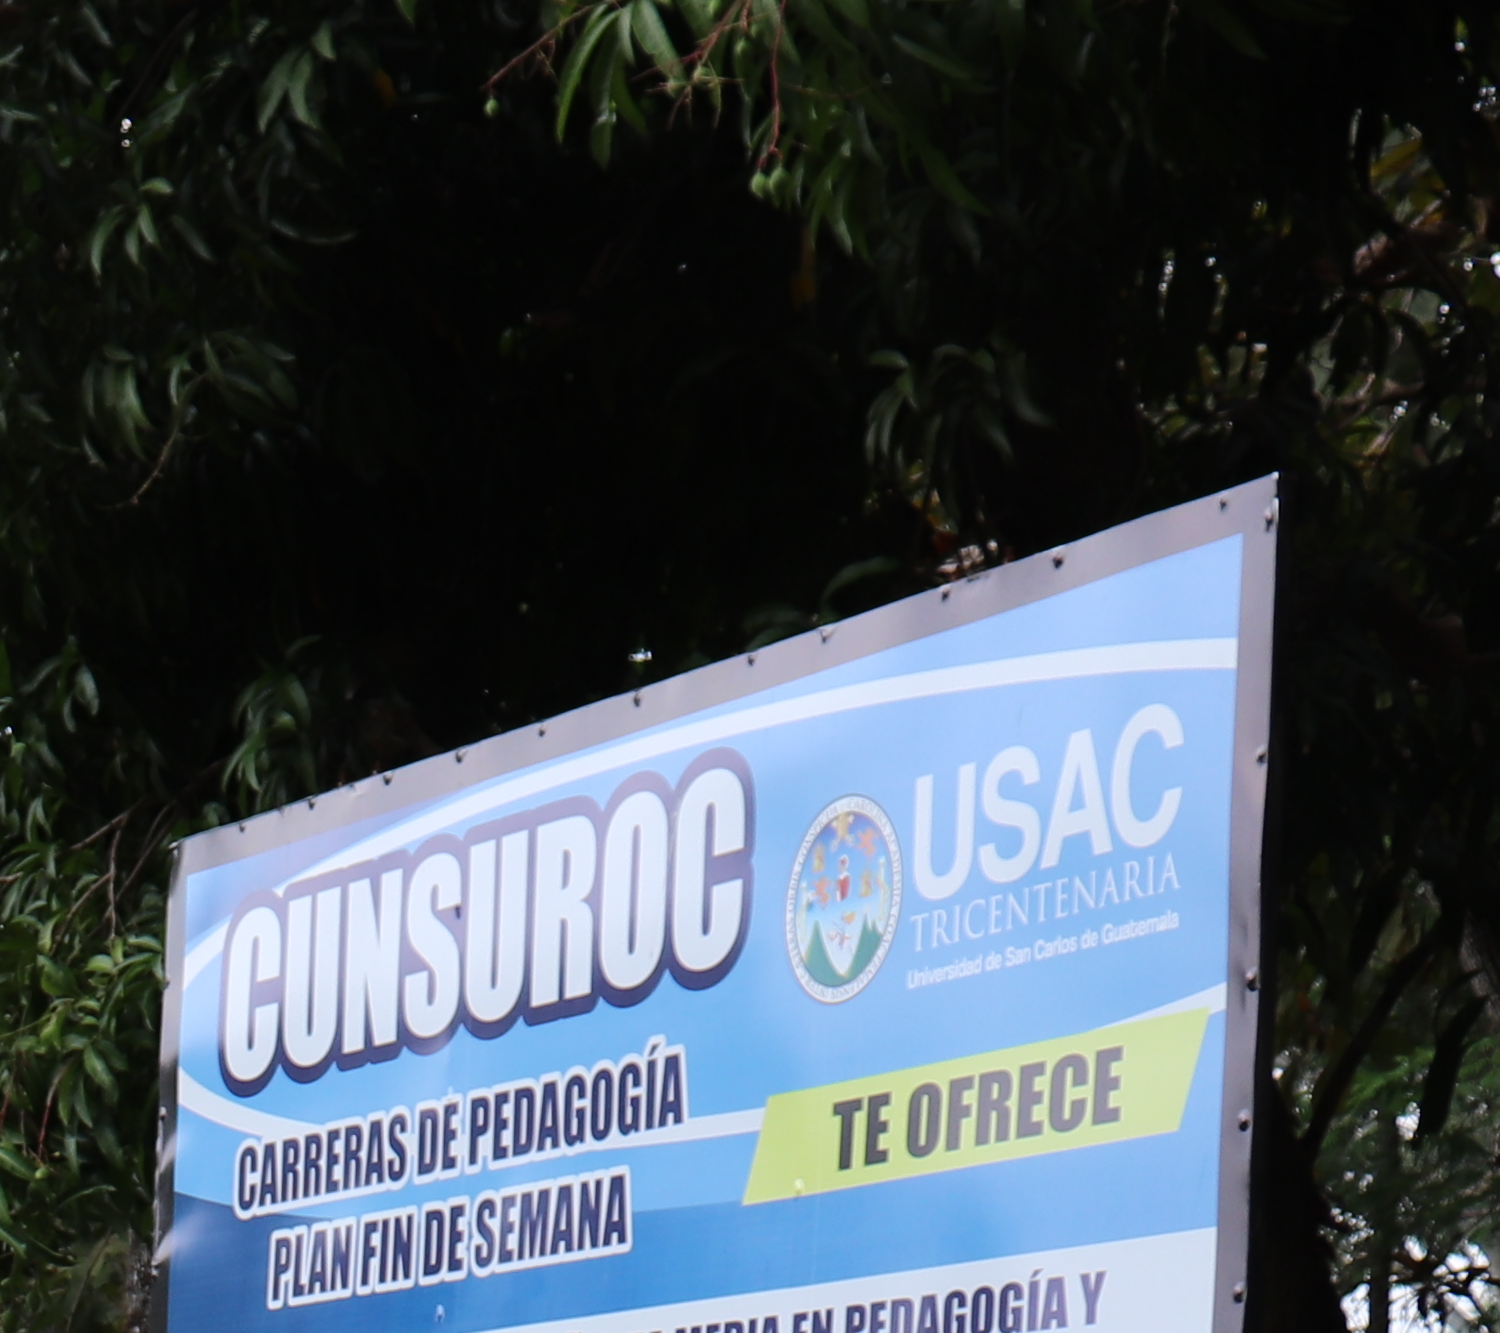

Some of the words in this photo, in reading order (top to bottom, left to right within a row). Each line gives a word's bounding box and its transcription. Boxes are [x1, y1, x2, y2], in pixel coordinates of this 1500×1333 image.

[913, 703, 1184, 900] USAC
[222, 766, 746, 1083] CUNSUROC
[906, 953, 983, 990] Universidad
[986, 948, 1002, 971] de
[1006, 946, 1031, 967] San
[1034, 935, 1078, 960] Carlos
[1081, 930, 1098, 949] de
[1102, 909, 1180, 944] Guatemala
[910, 852, 1181, 951] TRICENTENARIA
[237, 1113, 407, 1212] CARRERAS
[417, 1102, 459, 1176] DE
[468, 1042, 684, 1165] PEDAGOGÍA
[833, 1091, 892, 1171] TE
[906, 1045, 1124, 1158] OFRECE
[271, 1225, 353, 1301] PLAN
[361, 1213, 416, 1286] FIN
[422, 1204, 465, 1276] DE
[475, 1171, 628, 1267] SEMANA
[1079, 1270, 1107, 1326] Y
